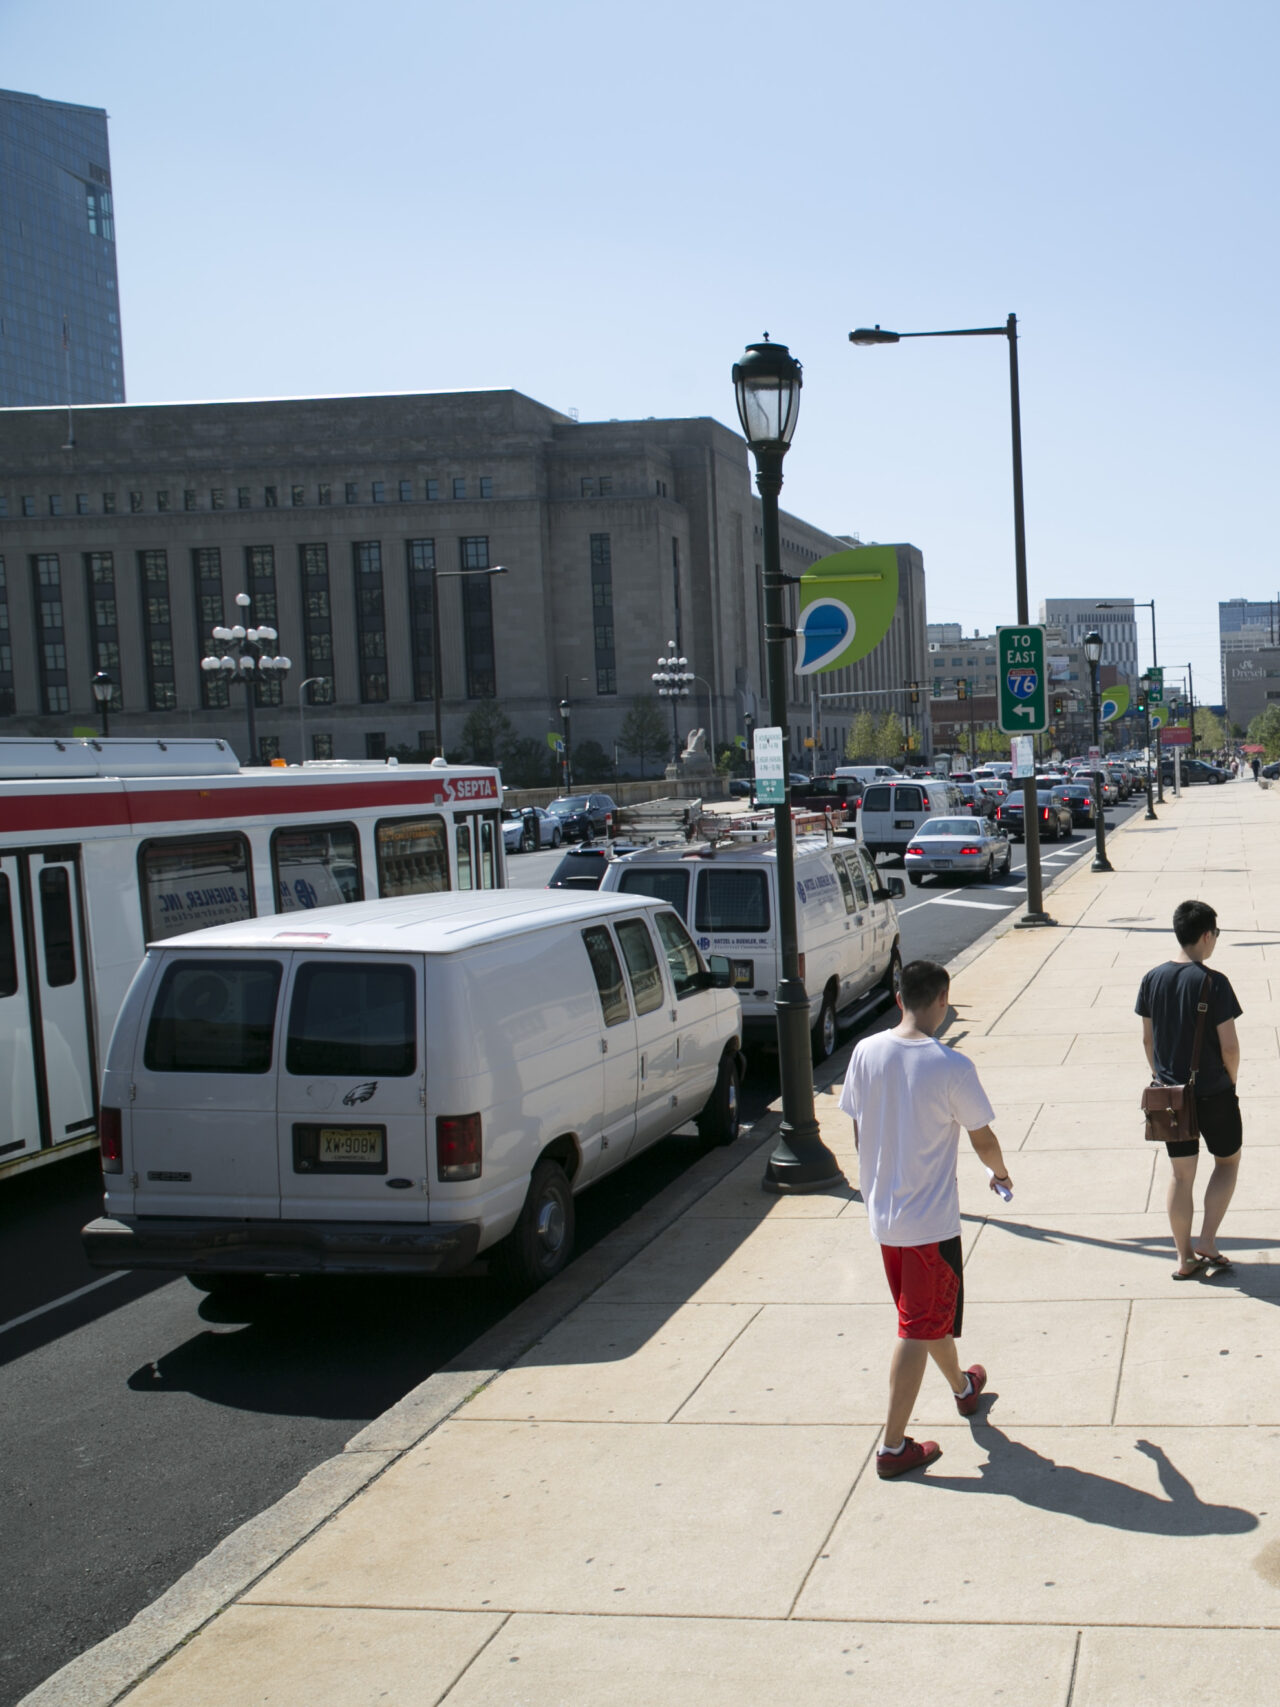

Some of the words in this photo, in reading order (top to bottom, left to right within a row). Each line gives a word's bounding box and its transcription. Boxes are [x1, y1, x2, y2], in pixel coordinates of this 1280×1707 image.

[1011, 634, 1031, 648] TO
[1007, 650, 1036, 664] EAST
[1010, 676, 1035, 693] 76
[456, 780, 492, 798] SEPTA
